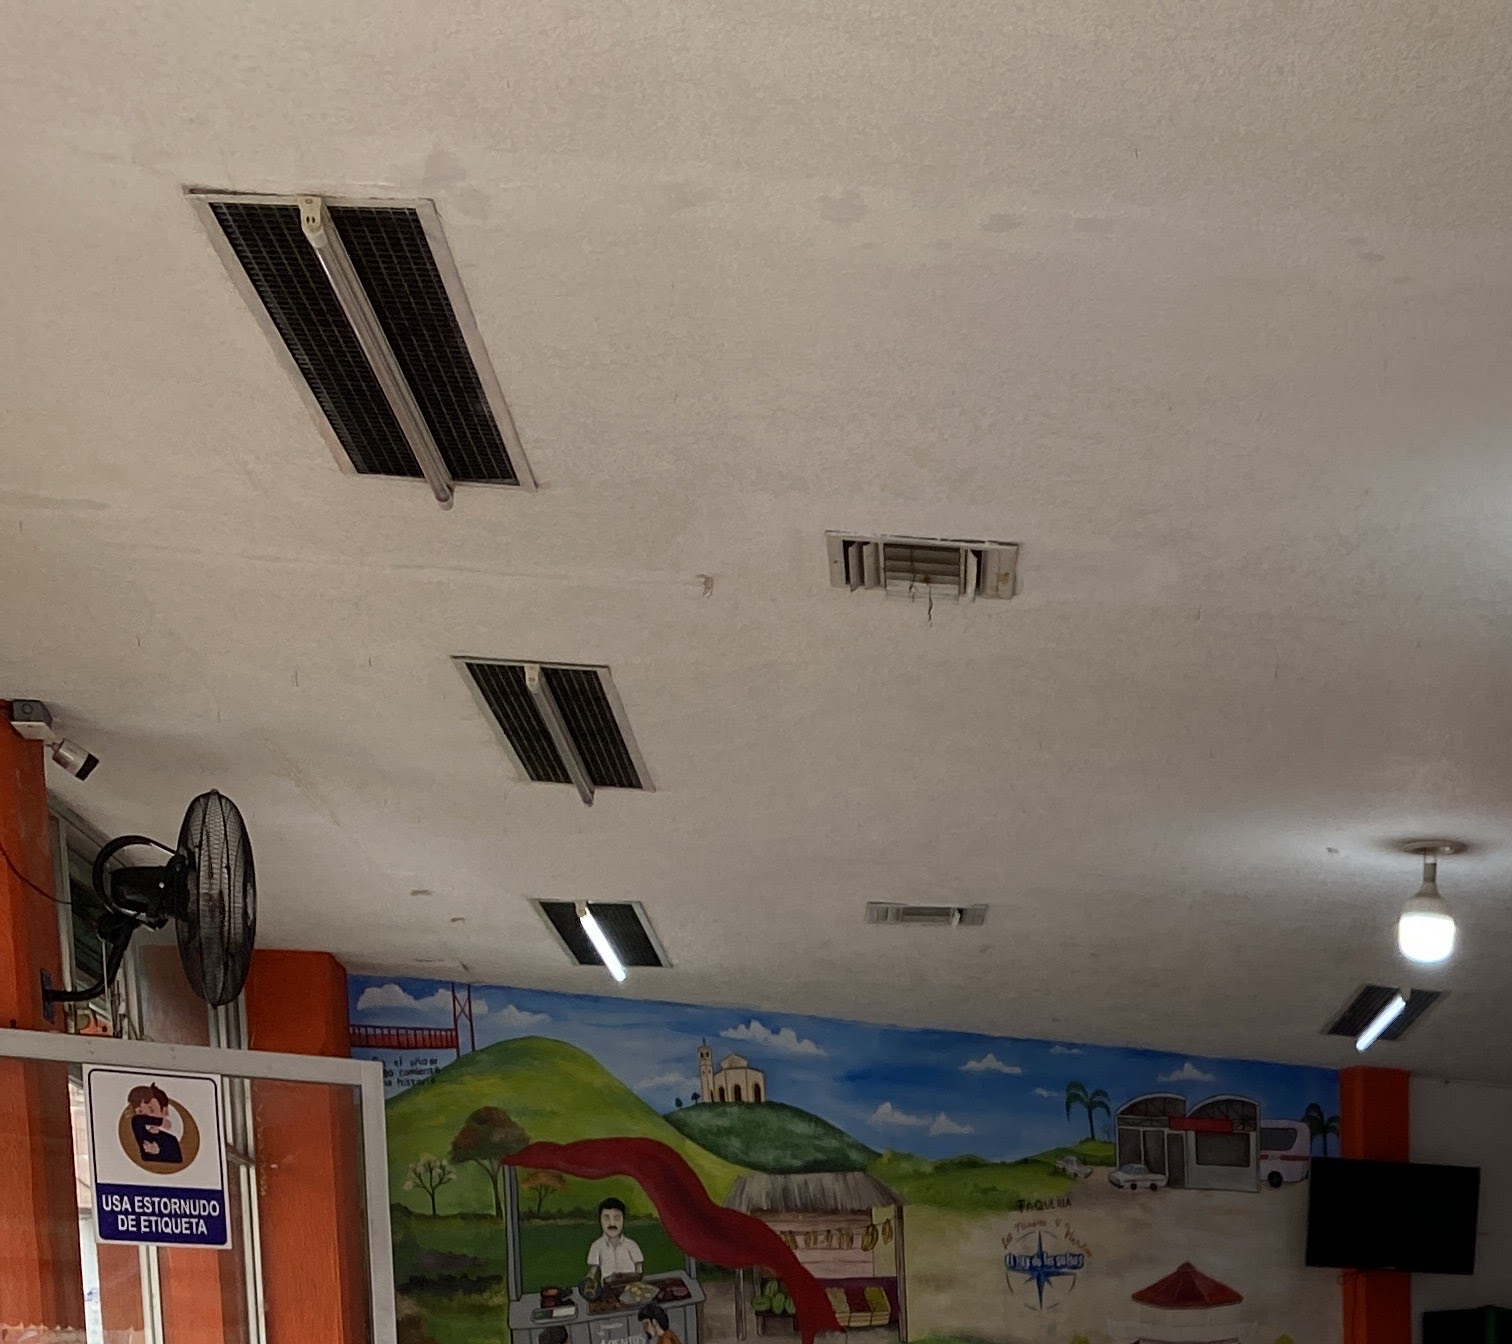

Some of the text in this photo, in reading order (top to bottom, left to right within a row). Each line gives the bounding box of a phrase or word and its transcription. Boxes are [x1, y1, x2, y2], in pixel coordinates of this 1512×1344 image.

[101, 1194, 220, 1217] USA ESTORNUDO
[117, 1214, 208, 1236] DE ETIQUETA
